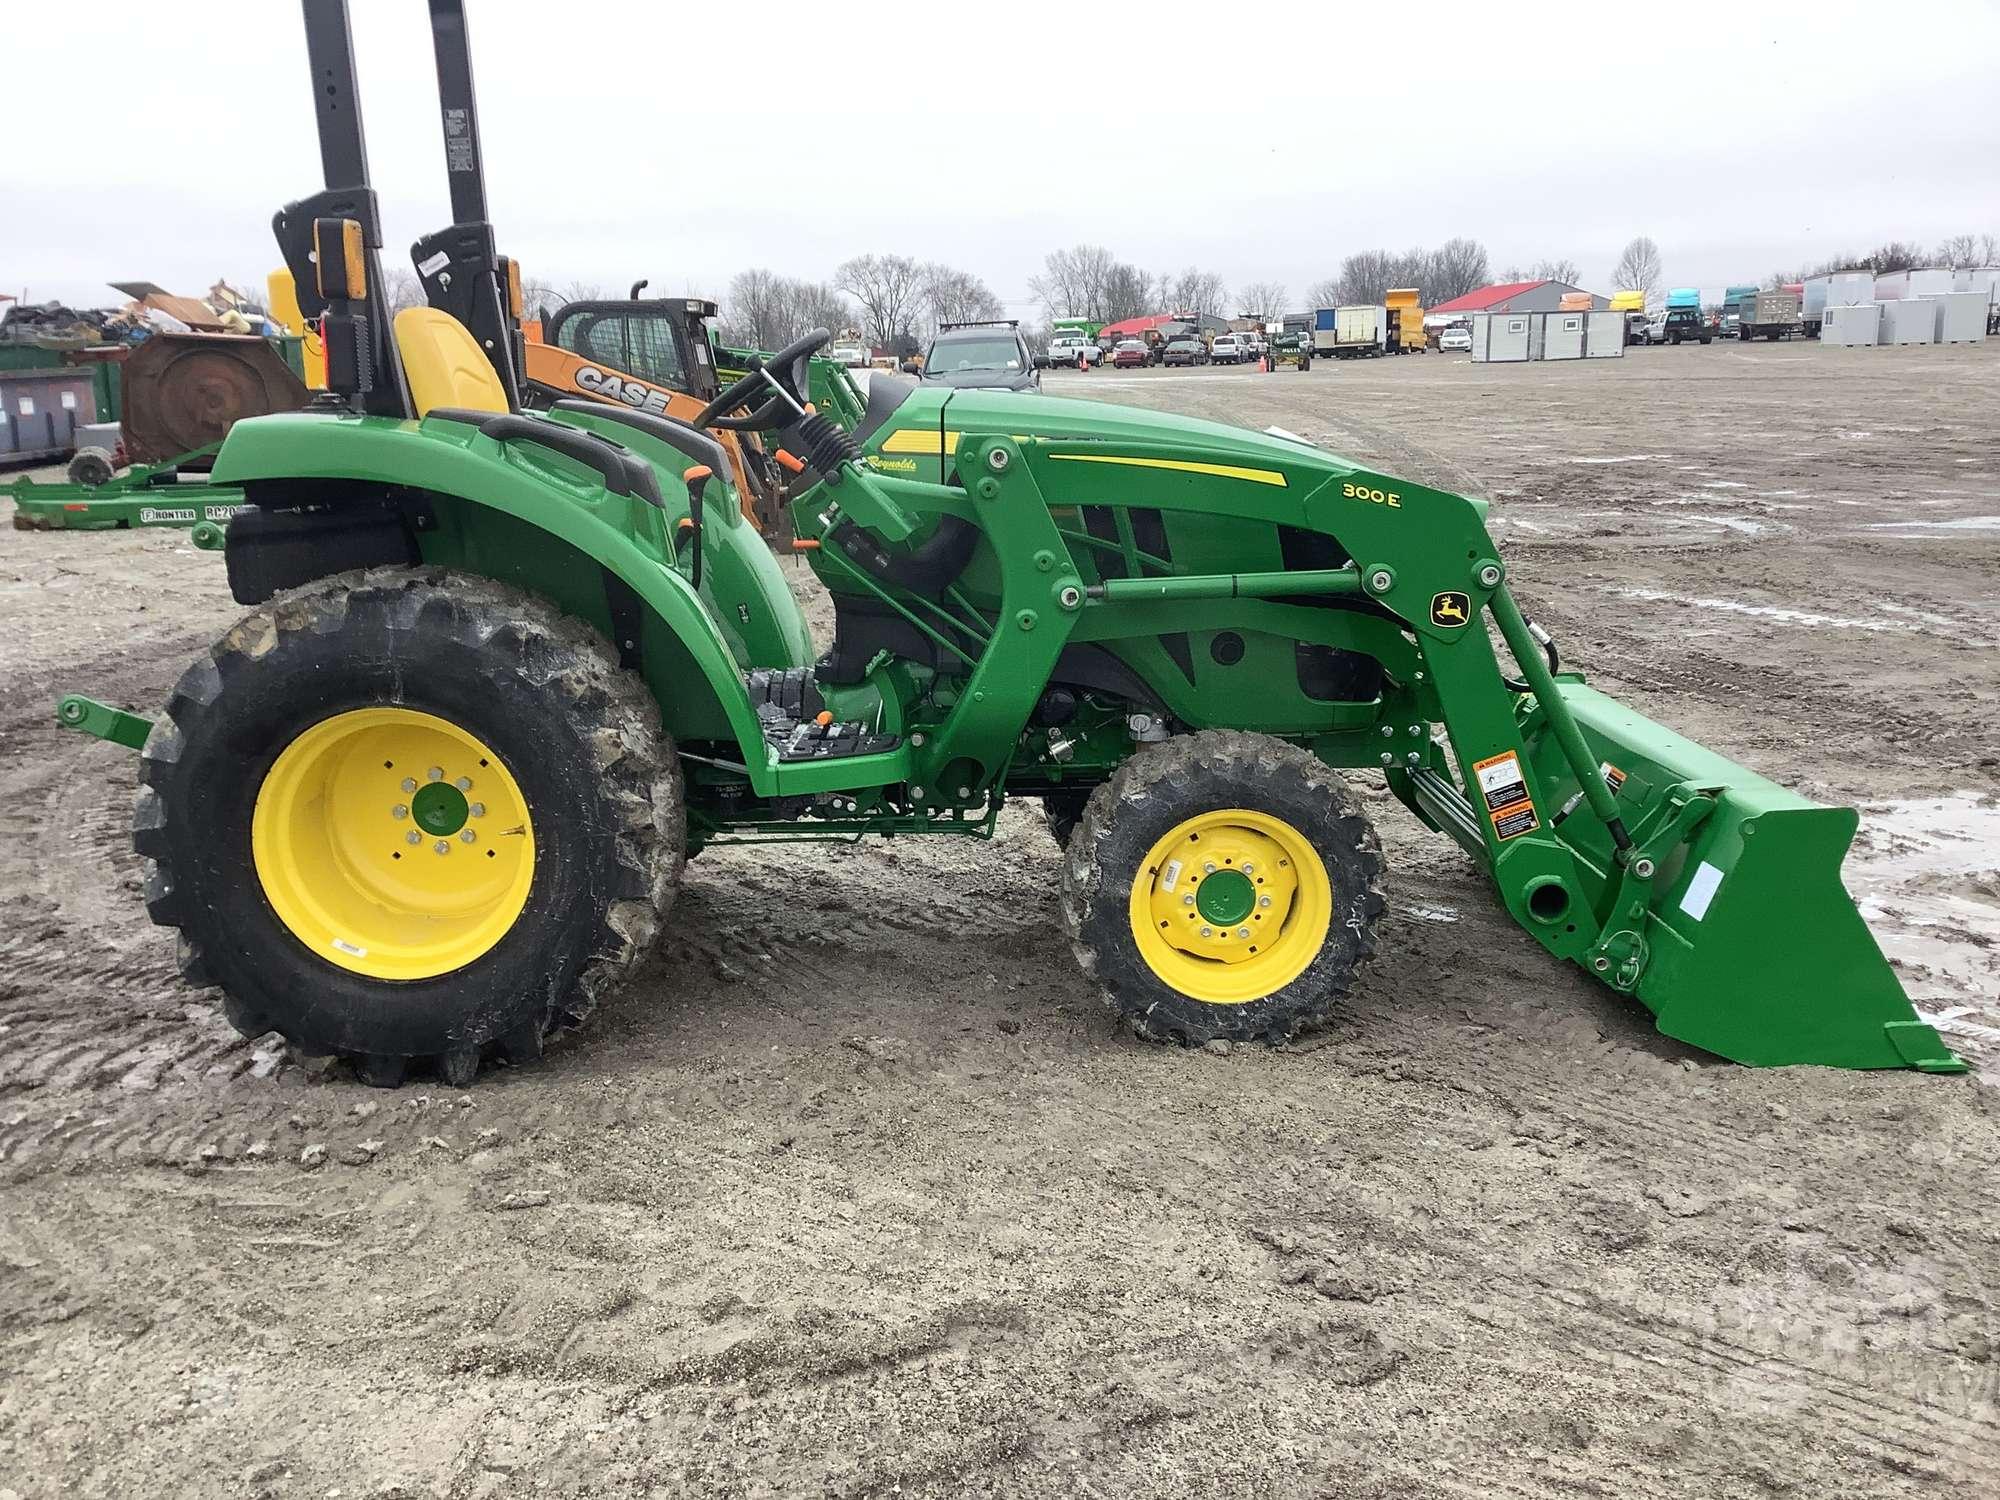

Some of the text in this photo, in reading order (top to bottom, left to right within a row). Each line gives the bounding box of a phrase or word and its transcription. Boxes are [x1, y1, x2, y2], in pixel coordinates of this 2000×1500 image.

[575, 366, 671, 412] CASE
[867, 455, 917, 471] Reynolds
[141, 509, 195, 521] FRONTIER
